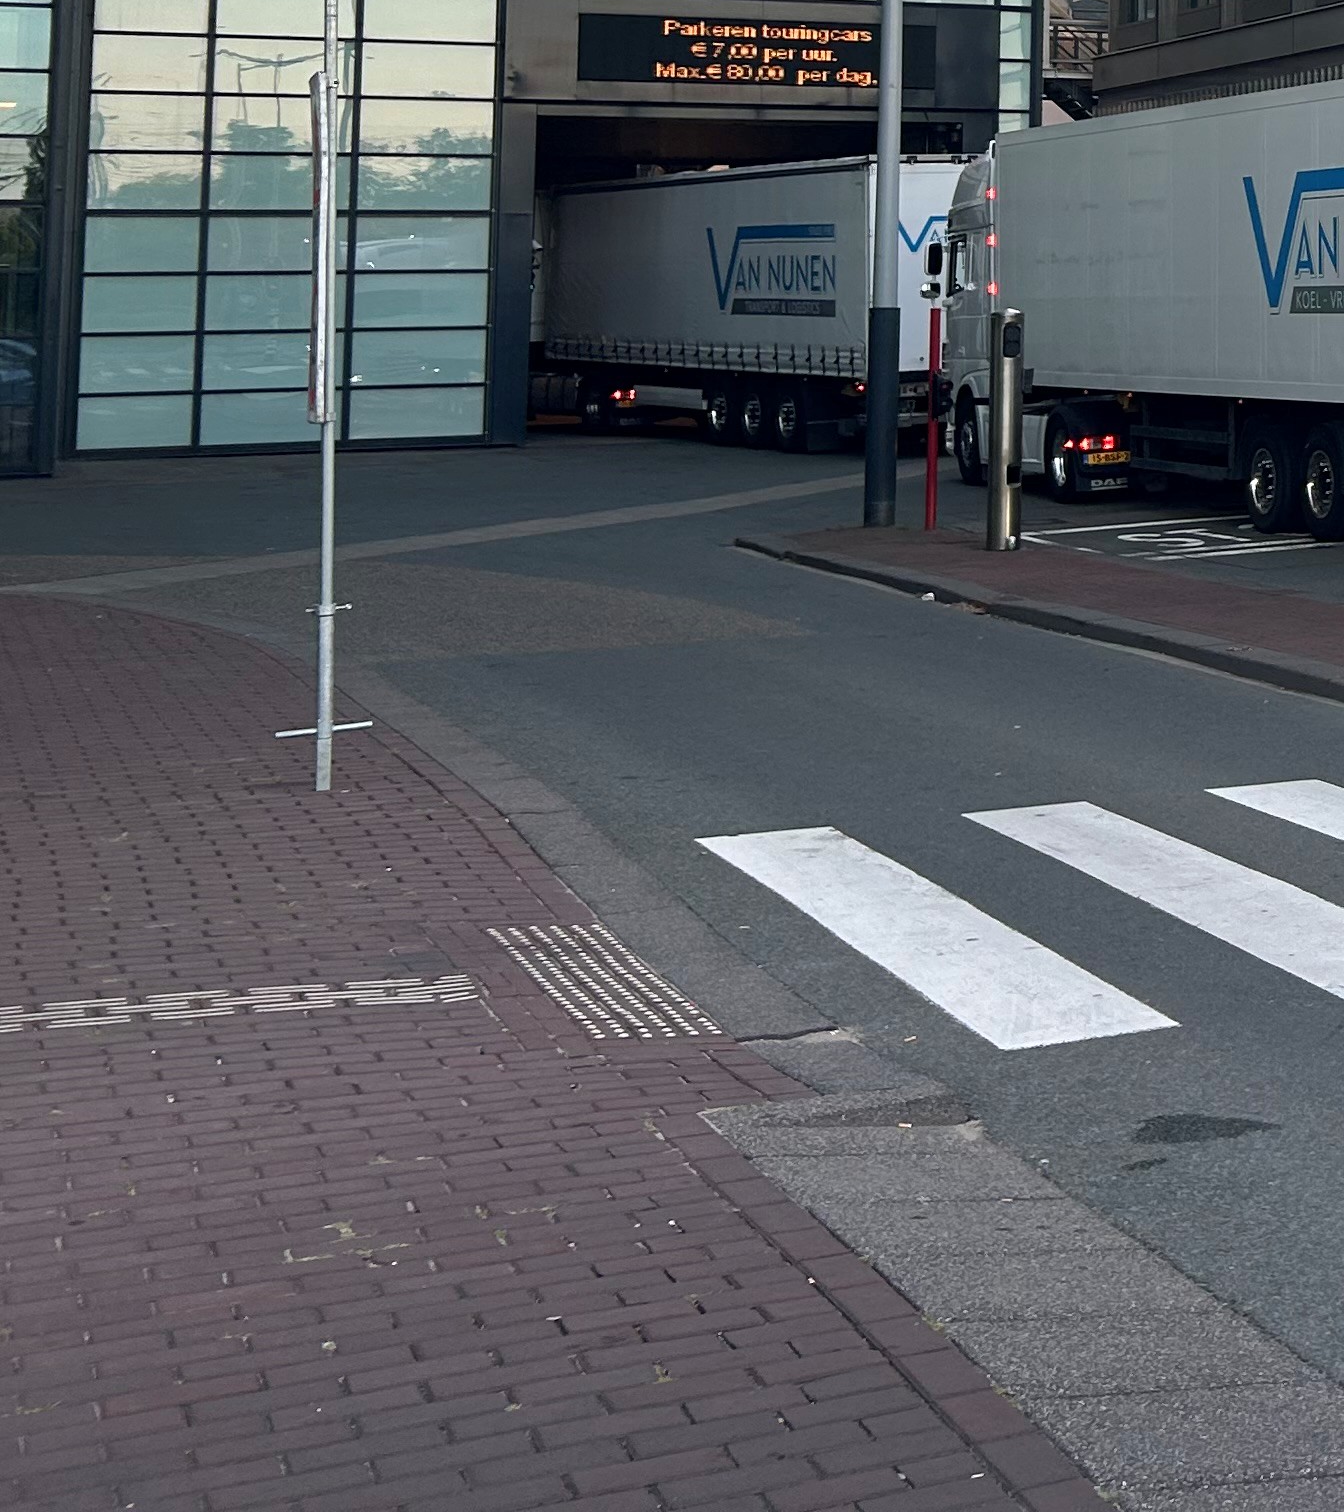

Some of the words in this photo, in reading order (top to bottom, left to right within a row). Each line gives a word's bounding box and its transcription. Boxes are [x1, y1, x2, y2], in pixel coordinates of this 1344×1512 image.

[663, 19, 756, 38] Parkeren
[762, 23, 873, 45] touringcars
[690, 42, 707, 58] €
[712, 42, 758, 60] 7,00
[763, 46, 798, 63] per
[802, 48, 839, 62] uur.
[726, 64, 785, 82] 80,00
[795, 68, 831, 86] per
[835, 67, 879, 87] dag.
[1243, 172, 1340, 311] VAN
[706, 226, 761, 311] VAN
[767, 254, 837, 293] NUNEN
[1295, 292, 1322, 309] KOEL
[1091, 477, 1128, 487] DAF
